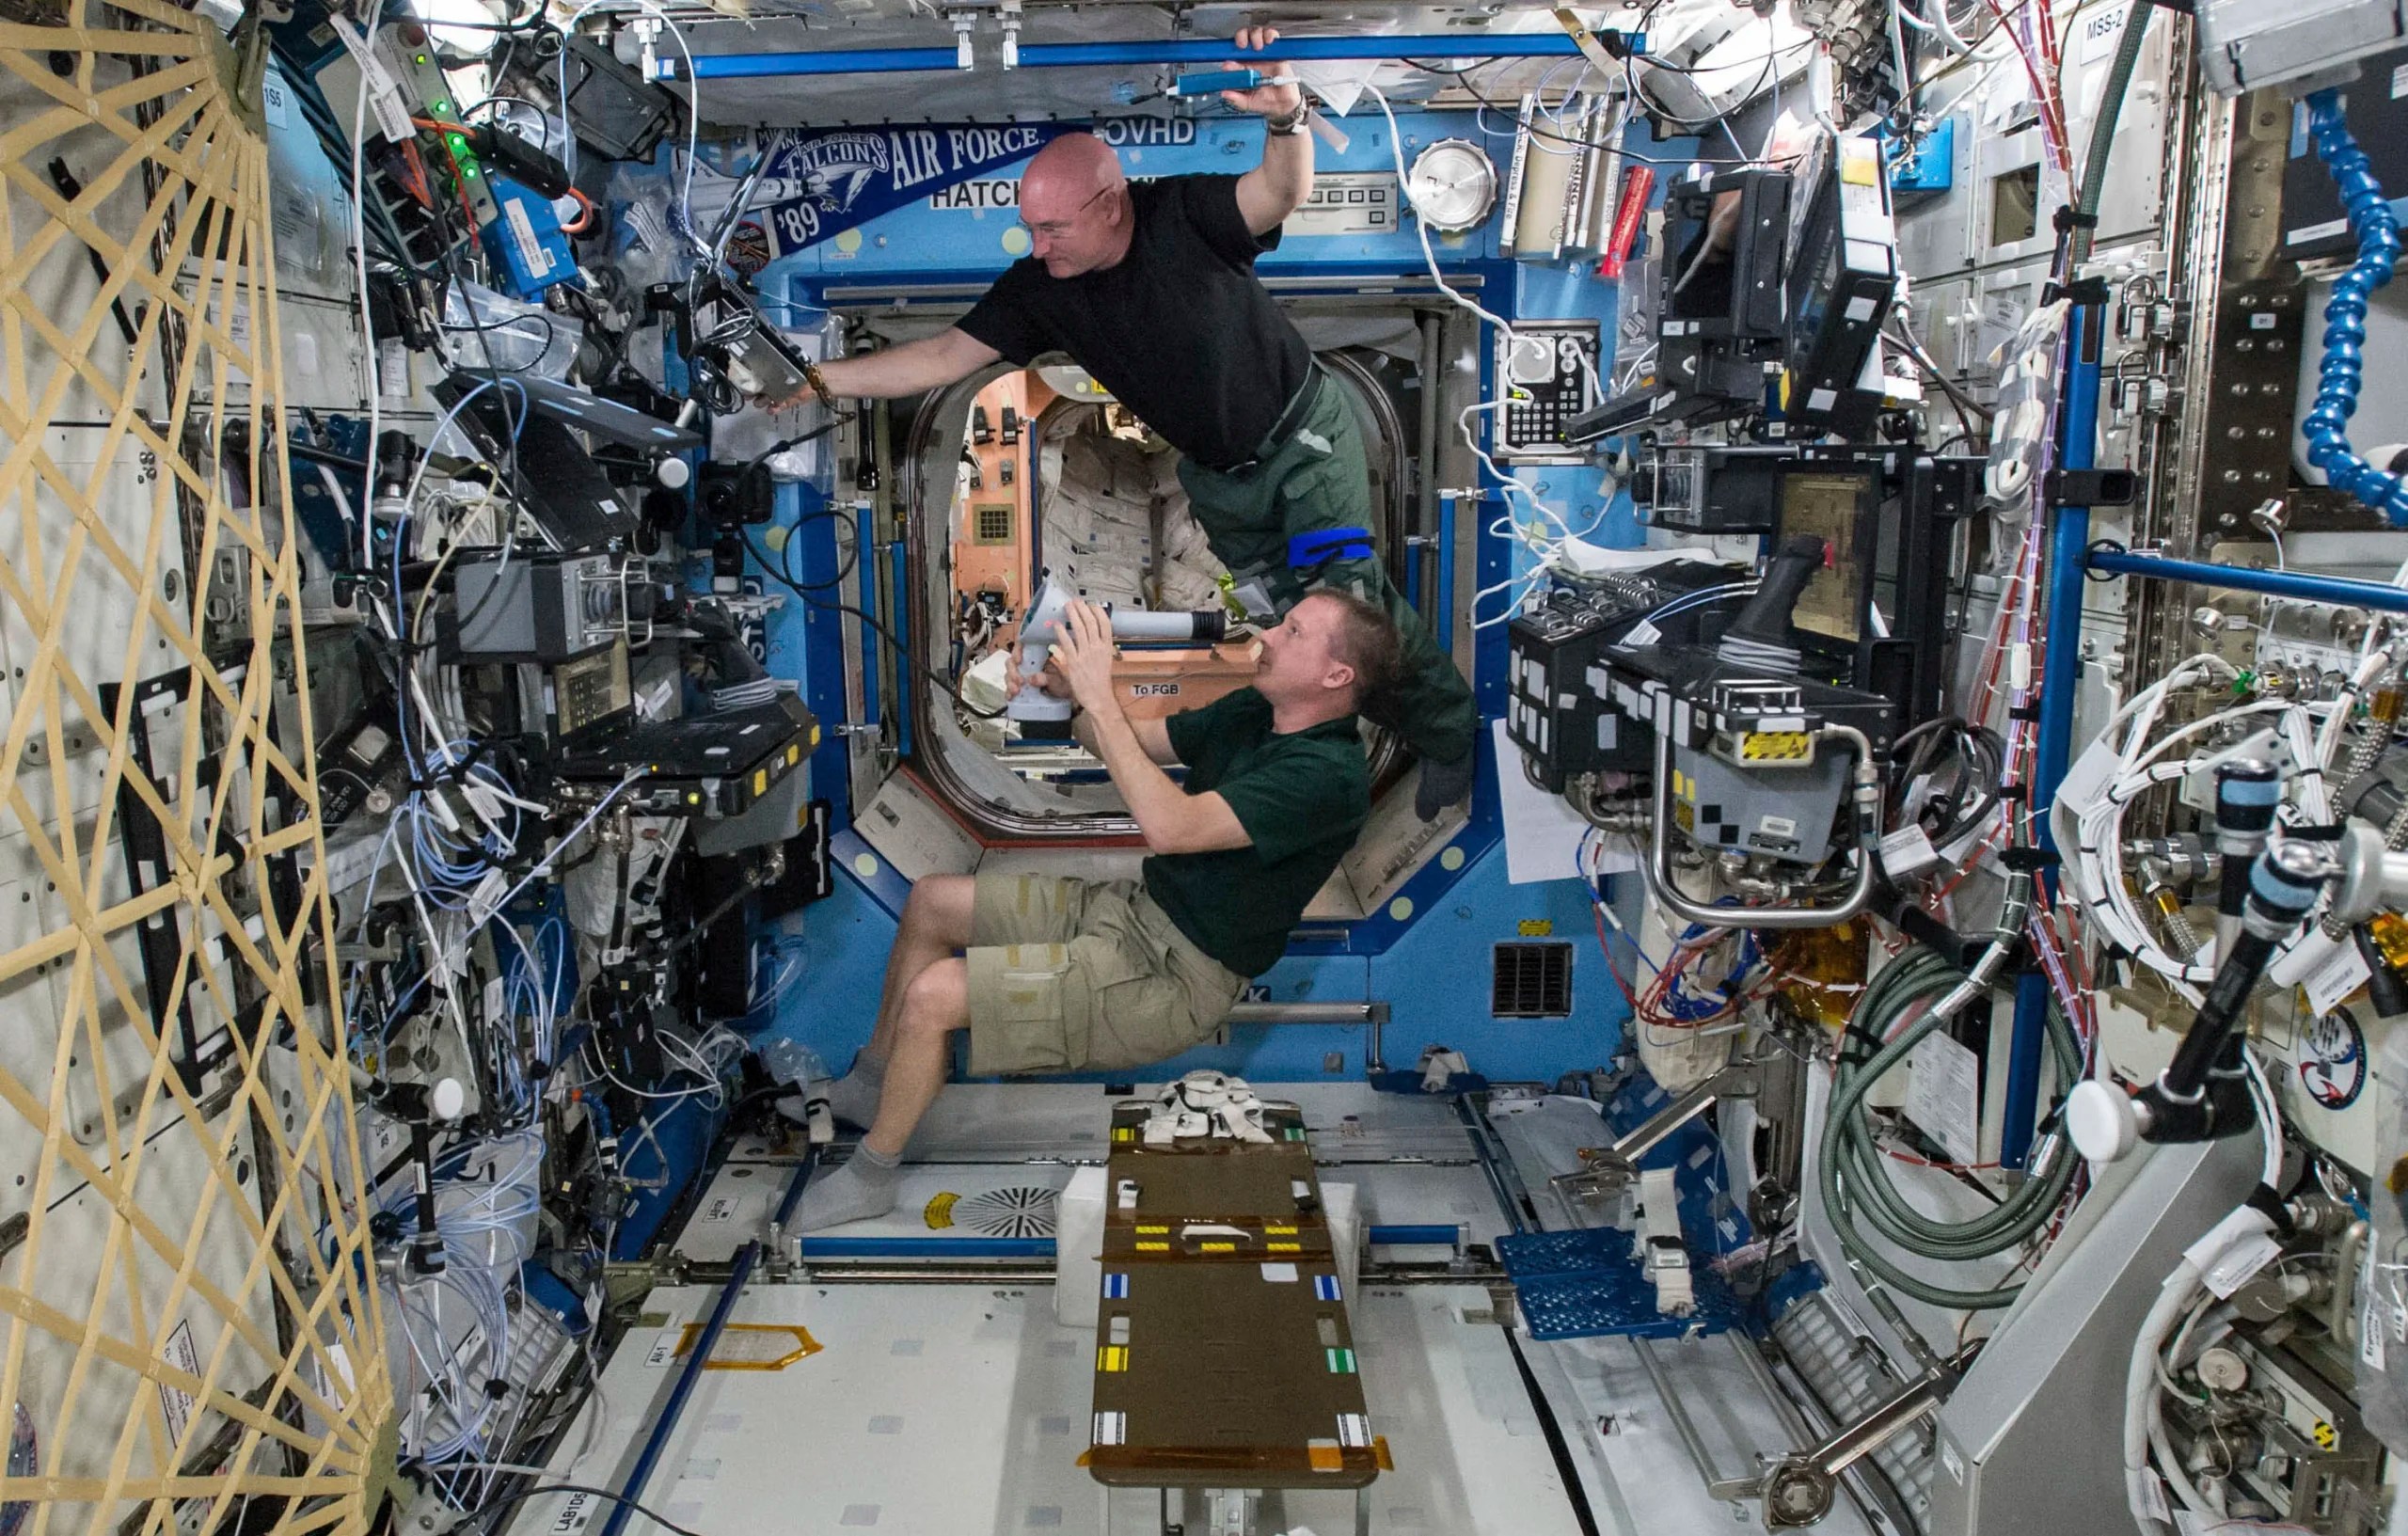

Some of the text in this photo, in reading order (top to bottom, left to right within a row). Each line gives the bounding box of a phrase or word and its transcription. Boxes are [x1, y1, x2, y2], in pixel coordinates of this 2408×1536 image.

[2087, 9, 2123, 40] MSS-2
[1104, 119, 1194, 145] OVHD
[789, 134, 890, 179] FALCONS
[892, 127, 1038, 190] AIR FORCE
[1510, 155, 1521, 191] Depress
[1133, 684, 1179, 695] To FGB
[650, 1346, 669, 1364] AV-1
[554, 1493, 588, 1532] LAB1D5
